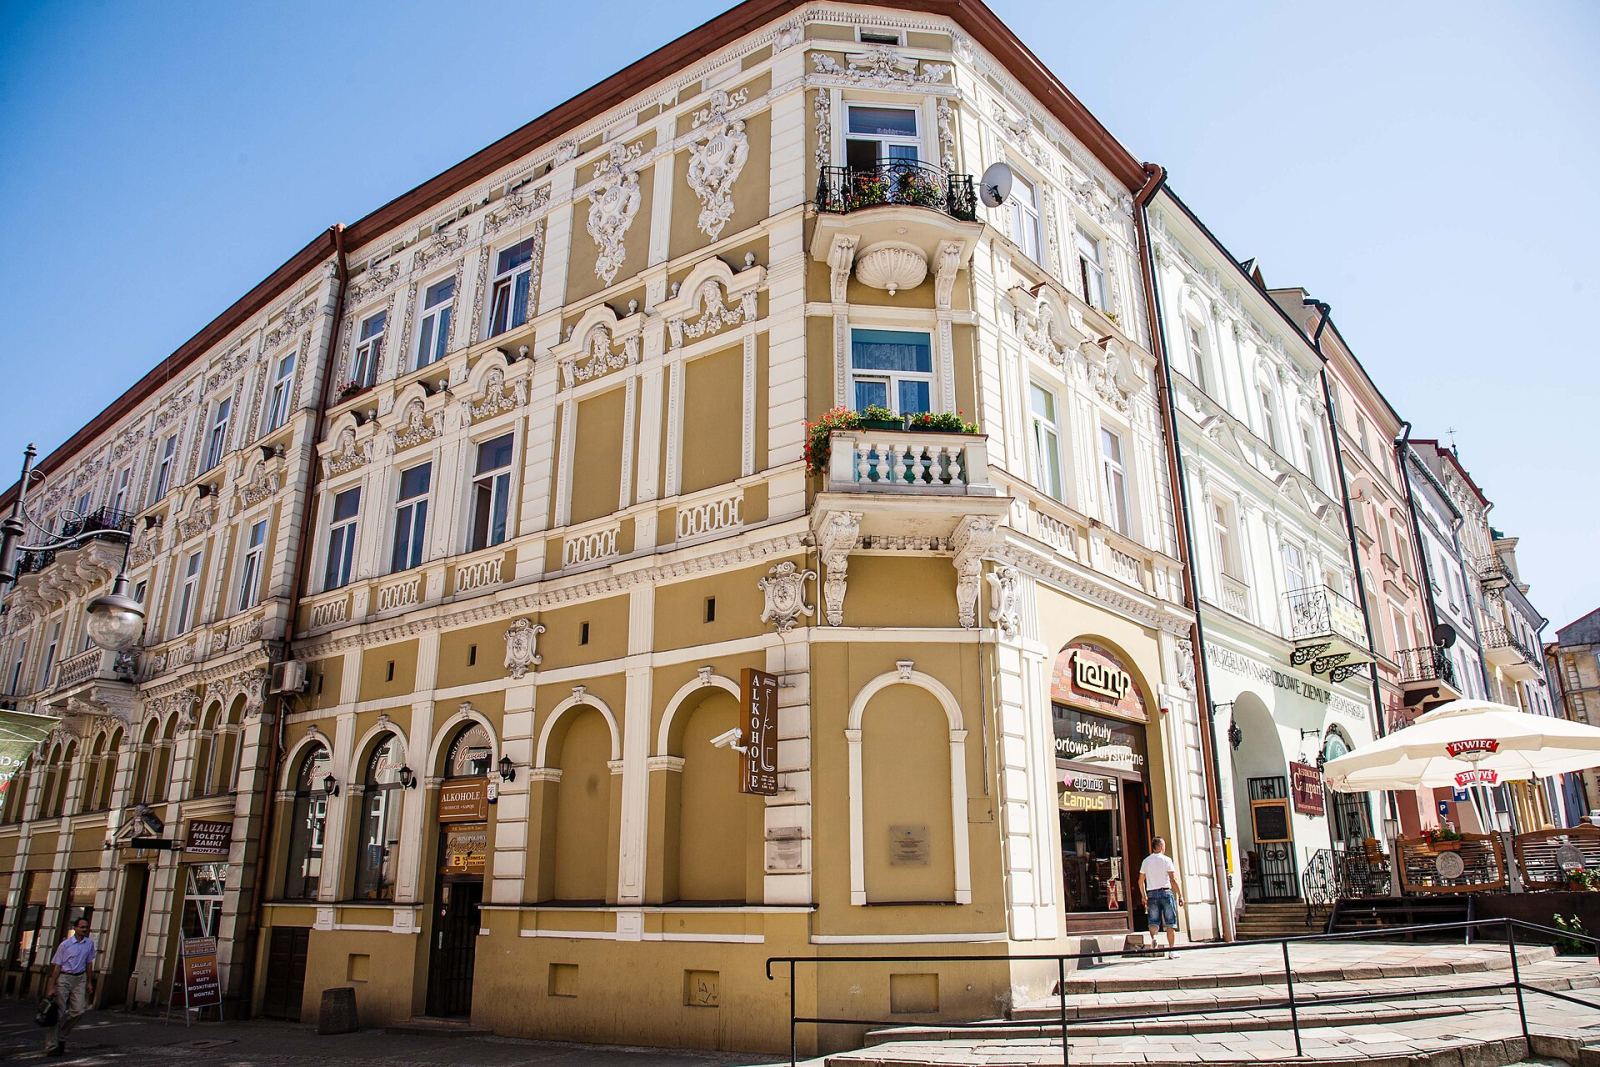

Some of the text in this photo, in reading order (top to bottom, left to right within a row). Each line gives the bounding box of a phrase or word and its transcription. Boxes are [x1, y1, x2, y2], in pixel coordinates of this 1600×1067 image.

[1074, 651, 1131, 700] tramp
[751, 674, 760, 788] ALKOHOLE
[1076, 721, 1112, 742] artykuły
[1055, 738, 1089, 754] ortowe
[1096, 742, 1143, 766] turystyczne
[1074, 776, 1104, 792] alpinus
[441, 791, 480, 802] ALKOHOLE
[193, 832, 226, 841] ROLETY
[194, 839, 222, 847] ZAMKI
